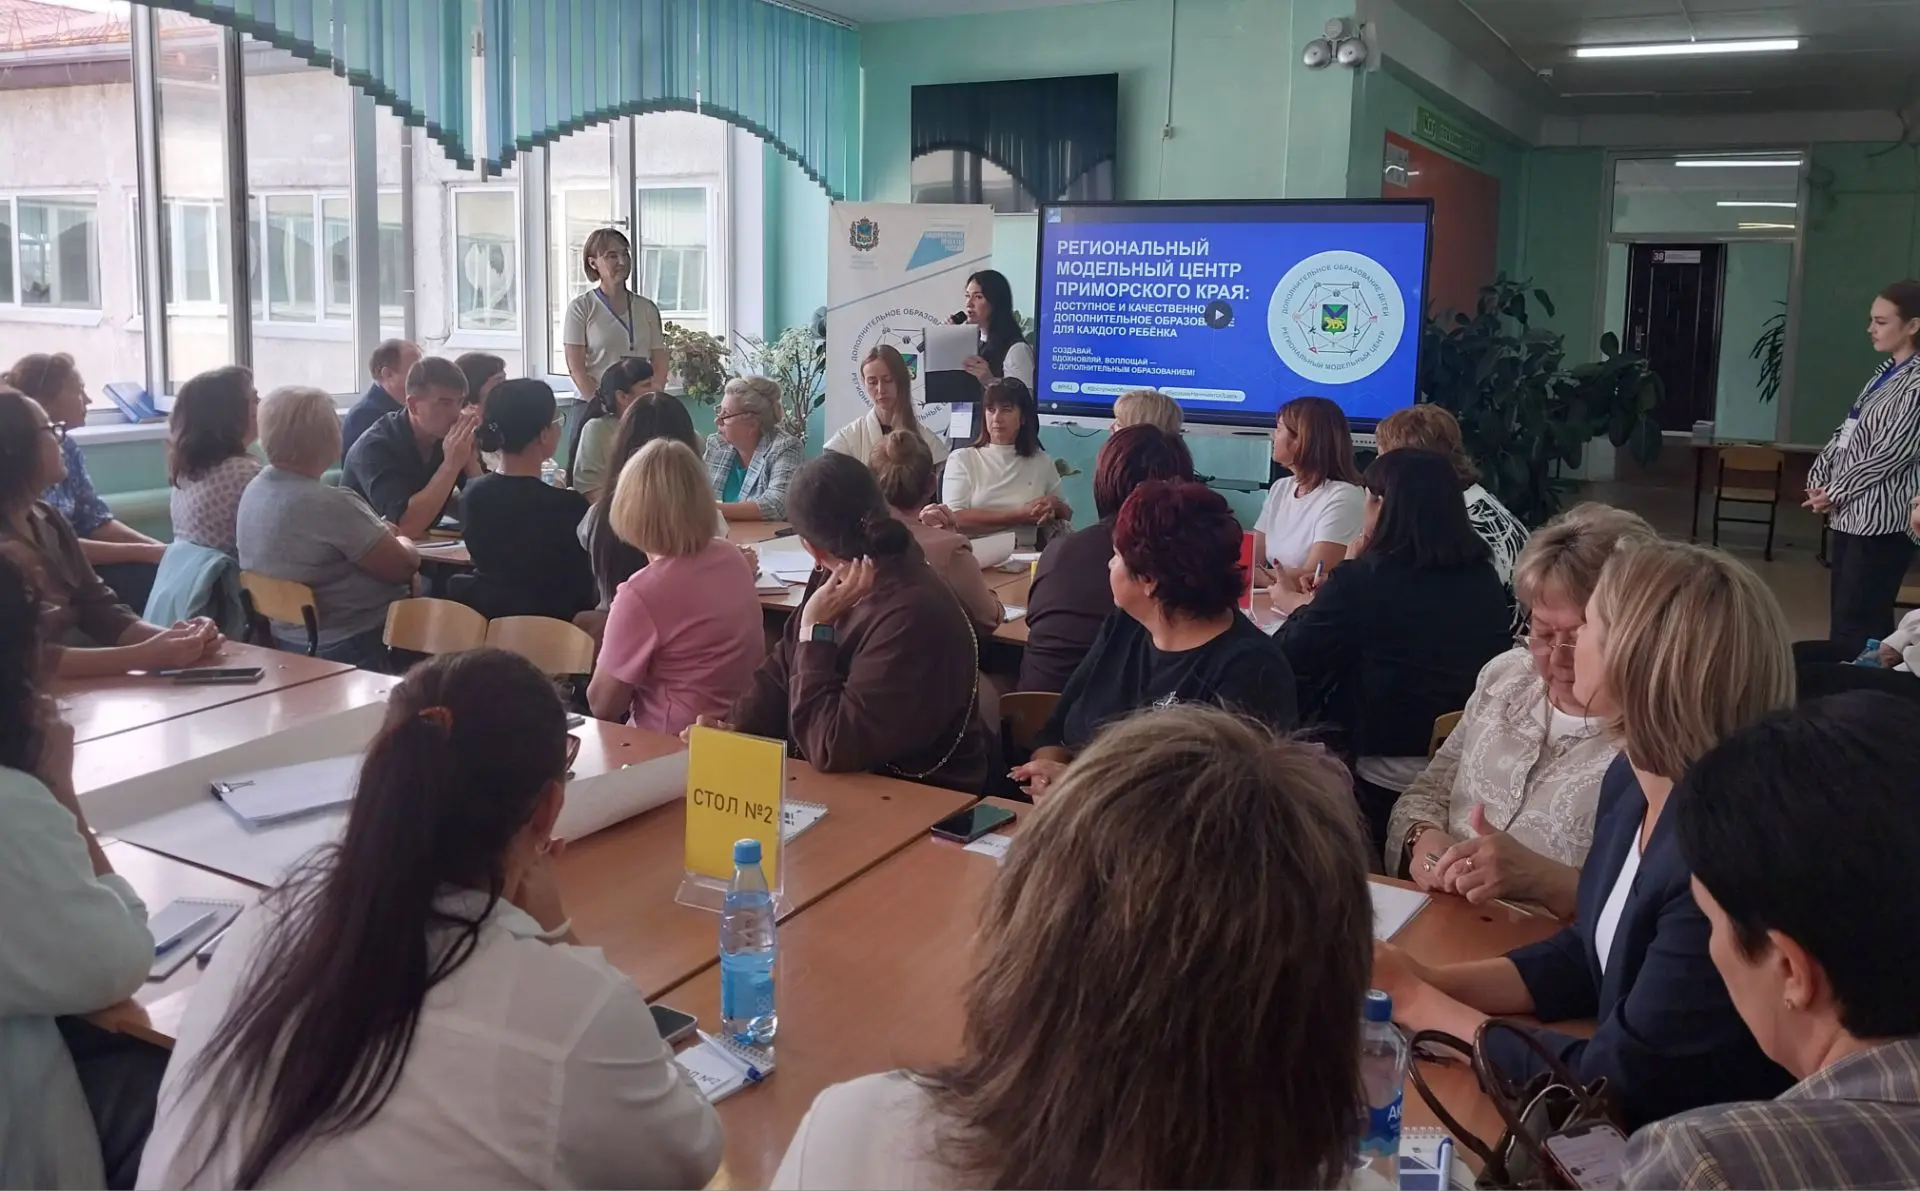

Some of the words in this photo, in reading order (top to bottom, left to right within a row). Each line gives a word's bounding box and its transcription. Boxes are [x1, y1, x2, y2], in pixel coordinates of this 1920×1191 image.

[1057, 238, 1209, 256] РЕГИОНАЛЬНЫЙ
[1056, 259, 1174, 278] МОДЕЛЬНЫЙ
[1179, 262, 1242, 280] ЦЕНТР
[1055, 281, 1191, 298] ПРИМОРСКОГО
[1195, 284, 1250, 300] КРАЯ:
[1054, 301, 1116, 312] ДОСТУПНОЕ
[1118, 303, 1126, 312] И
[1128, 303, 1206, 314] КАЧЕСТВЕННО
[1053, 313, 1152, 325] ДОПОЛНИТЕЛЬНОЕ
[1154, 315, 1235, 328] ОБРАЗОВЕ
[851, 308, 901, 362] ДОПОЛНИТЕЛЬНОЕ
[903, 308, 942, 326] ОБРАЗОВ
[1053, 324, 1075, 335] ДЛЯ
[1076, 326, 1126, 337] КАЖДОГО
[1128, 326, 1178, 338] РЕБЁНКА
[1052, 346, 1093, 355] СОЗДАВАЙ,
[1104, 356, 1148, 366] ВОПЛОЩАЙ
[1058, 363, 1130, 373] ДОПОЛНИТЕЛЬНЫМ
[1131, 366, 1196, 377] ОБРАЗОВАНИЕМ!
[693, 788, 738, 815] СТОЛ
[745, 801, 773, 824] №2
